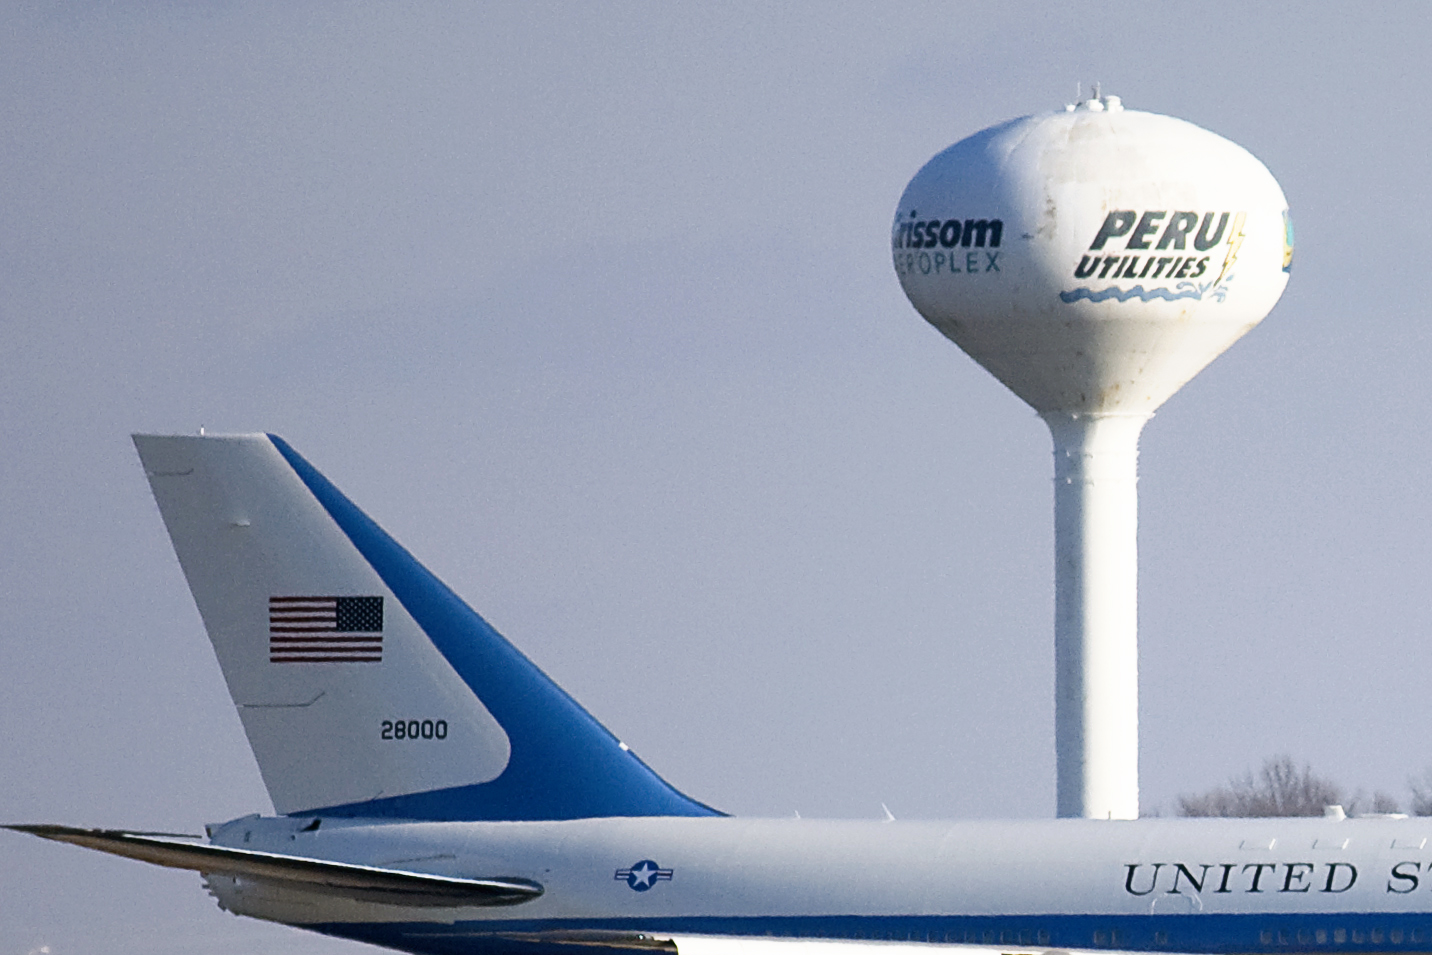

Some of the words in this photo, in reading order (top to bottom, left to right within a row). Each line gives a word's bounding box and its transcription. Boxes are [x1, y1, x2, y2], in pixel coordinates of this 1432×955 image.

[894, 209, 1003, 248] rissom
[1089, 210, 1230, 251] PERU
[1074, 255, 1210, 279] UTILITIES
[381, 720, 448, 740] 28000
[1123, 863, 1358, 896] UNITED
